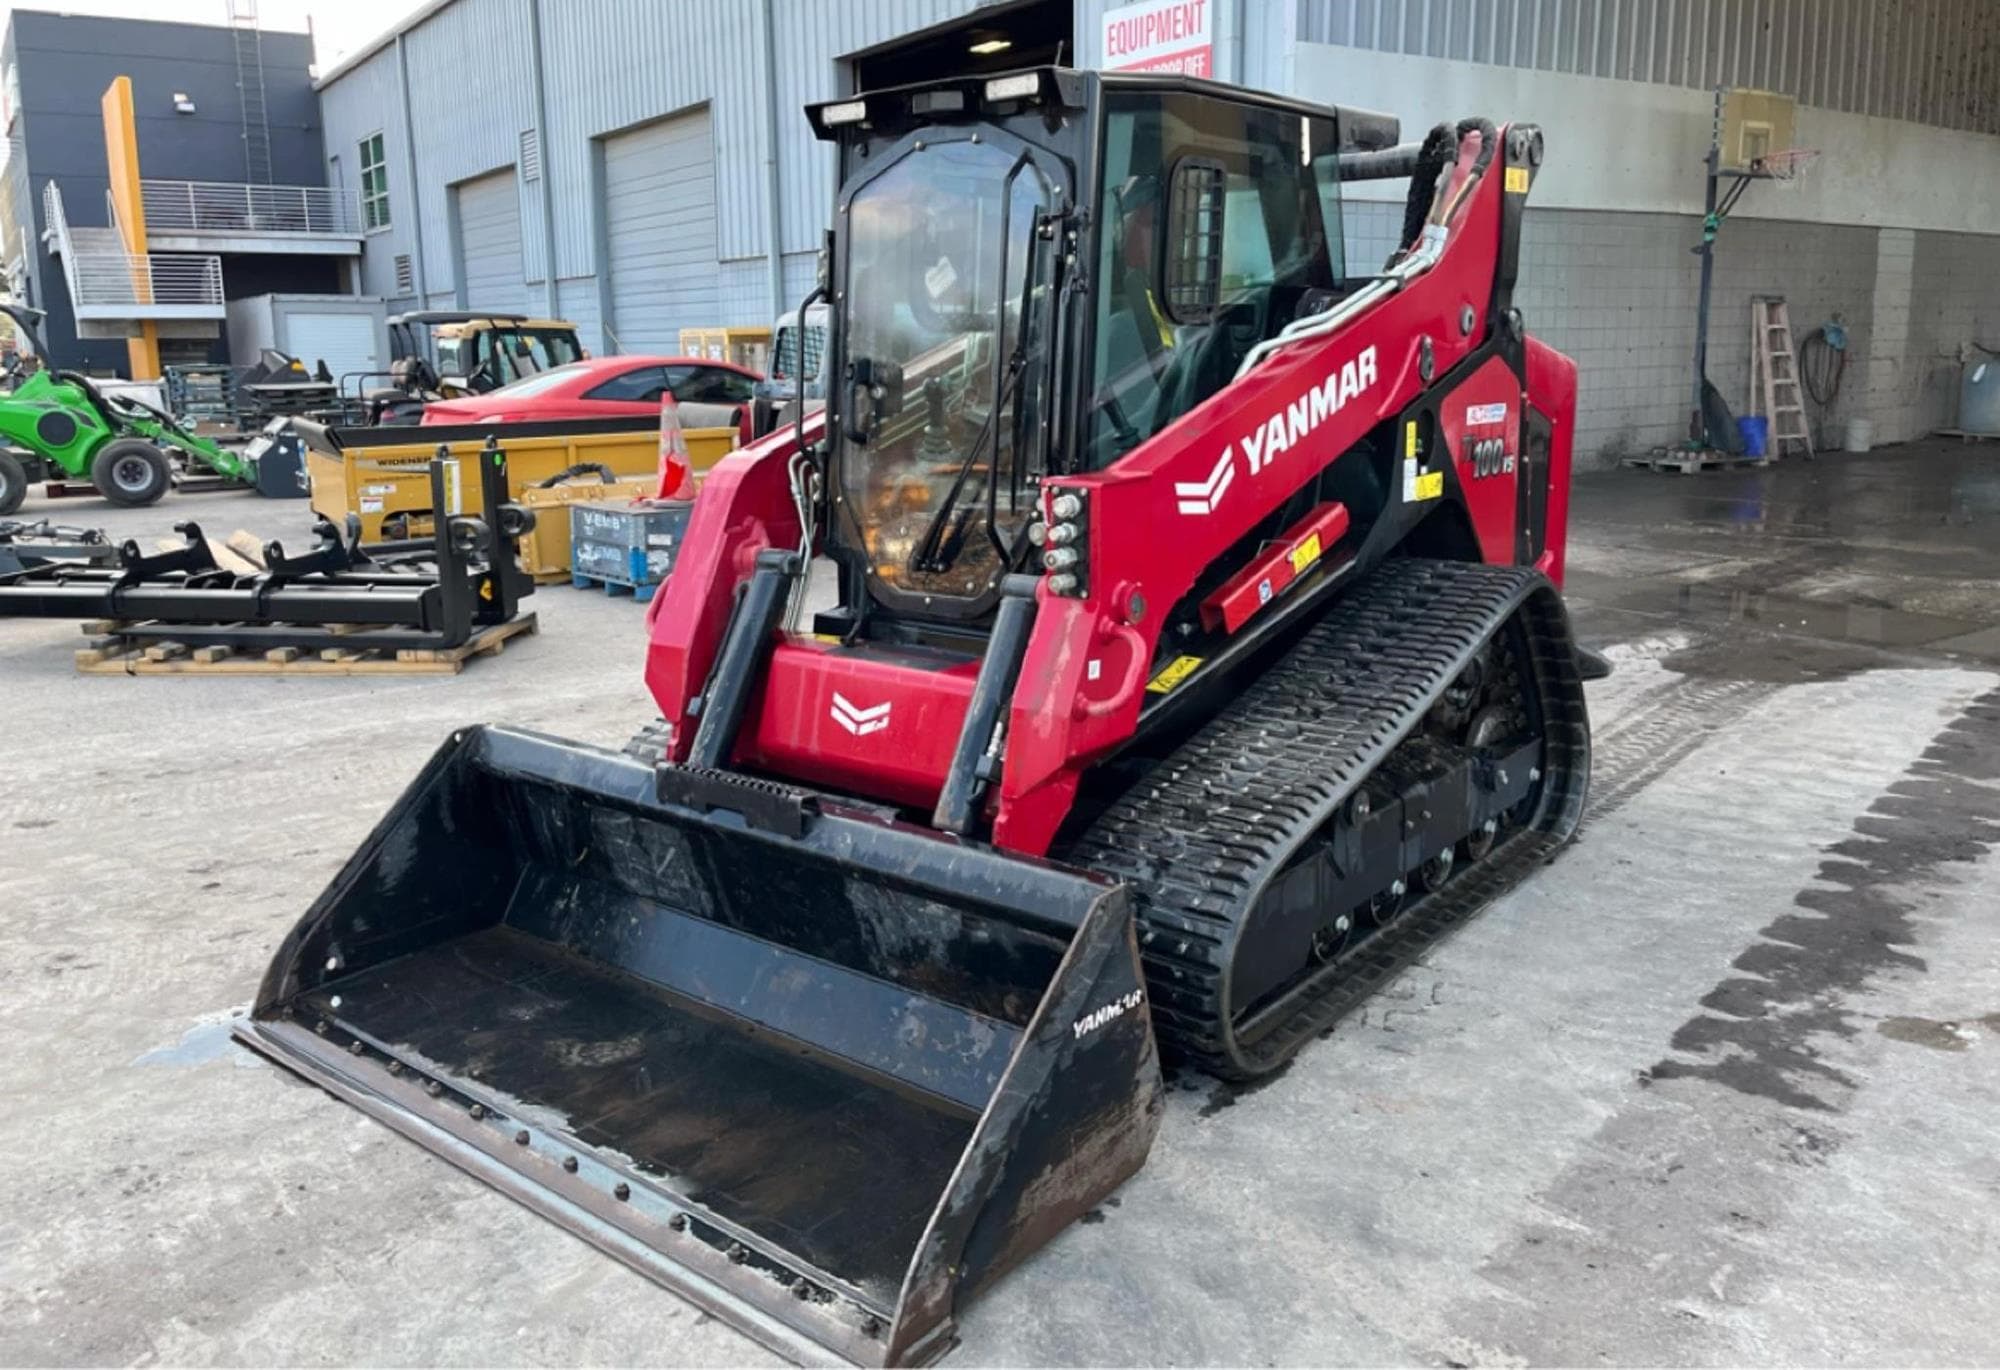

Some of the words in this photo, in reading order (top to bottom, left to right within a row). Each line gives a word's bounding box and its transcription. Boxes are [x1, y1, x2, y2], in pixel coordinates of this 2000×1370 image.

[1108, 0, 1206, 57] EQUIPMENT
[1240, 344, 1377, 476] YANMAR
[1073, 988, 1142, 1039] YANMAR
